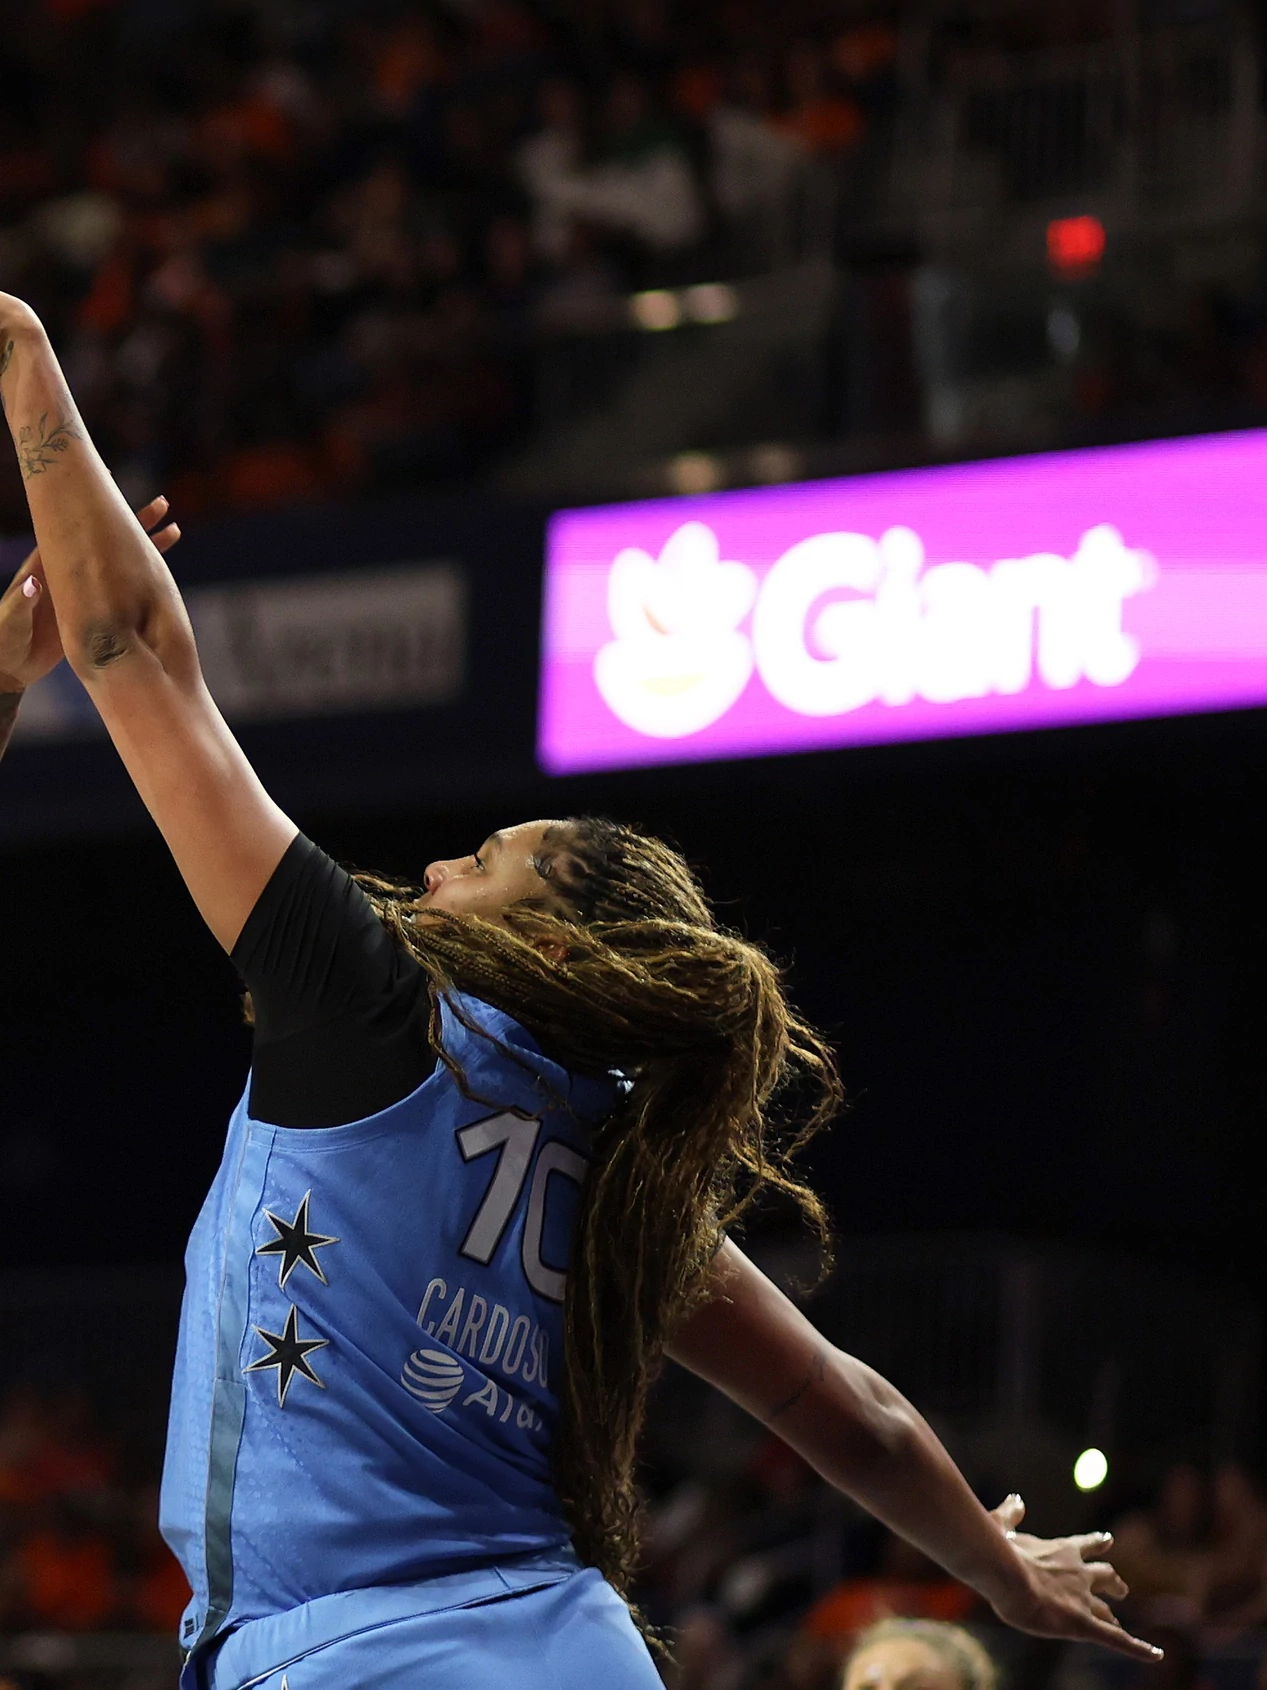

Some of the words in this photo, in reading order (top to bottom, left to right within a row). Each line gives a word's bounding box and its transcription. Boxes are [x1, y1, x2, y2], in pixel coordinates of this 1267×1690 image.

[754, 523, 1160, 719] Giant
[455, 1107, 588, 1304] 10
[416, 1277, 550, 1389] CARDOSO
